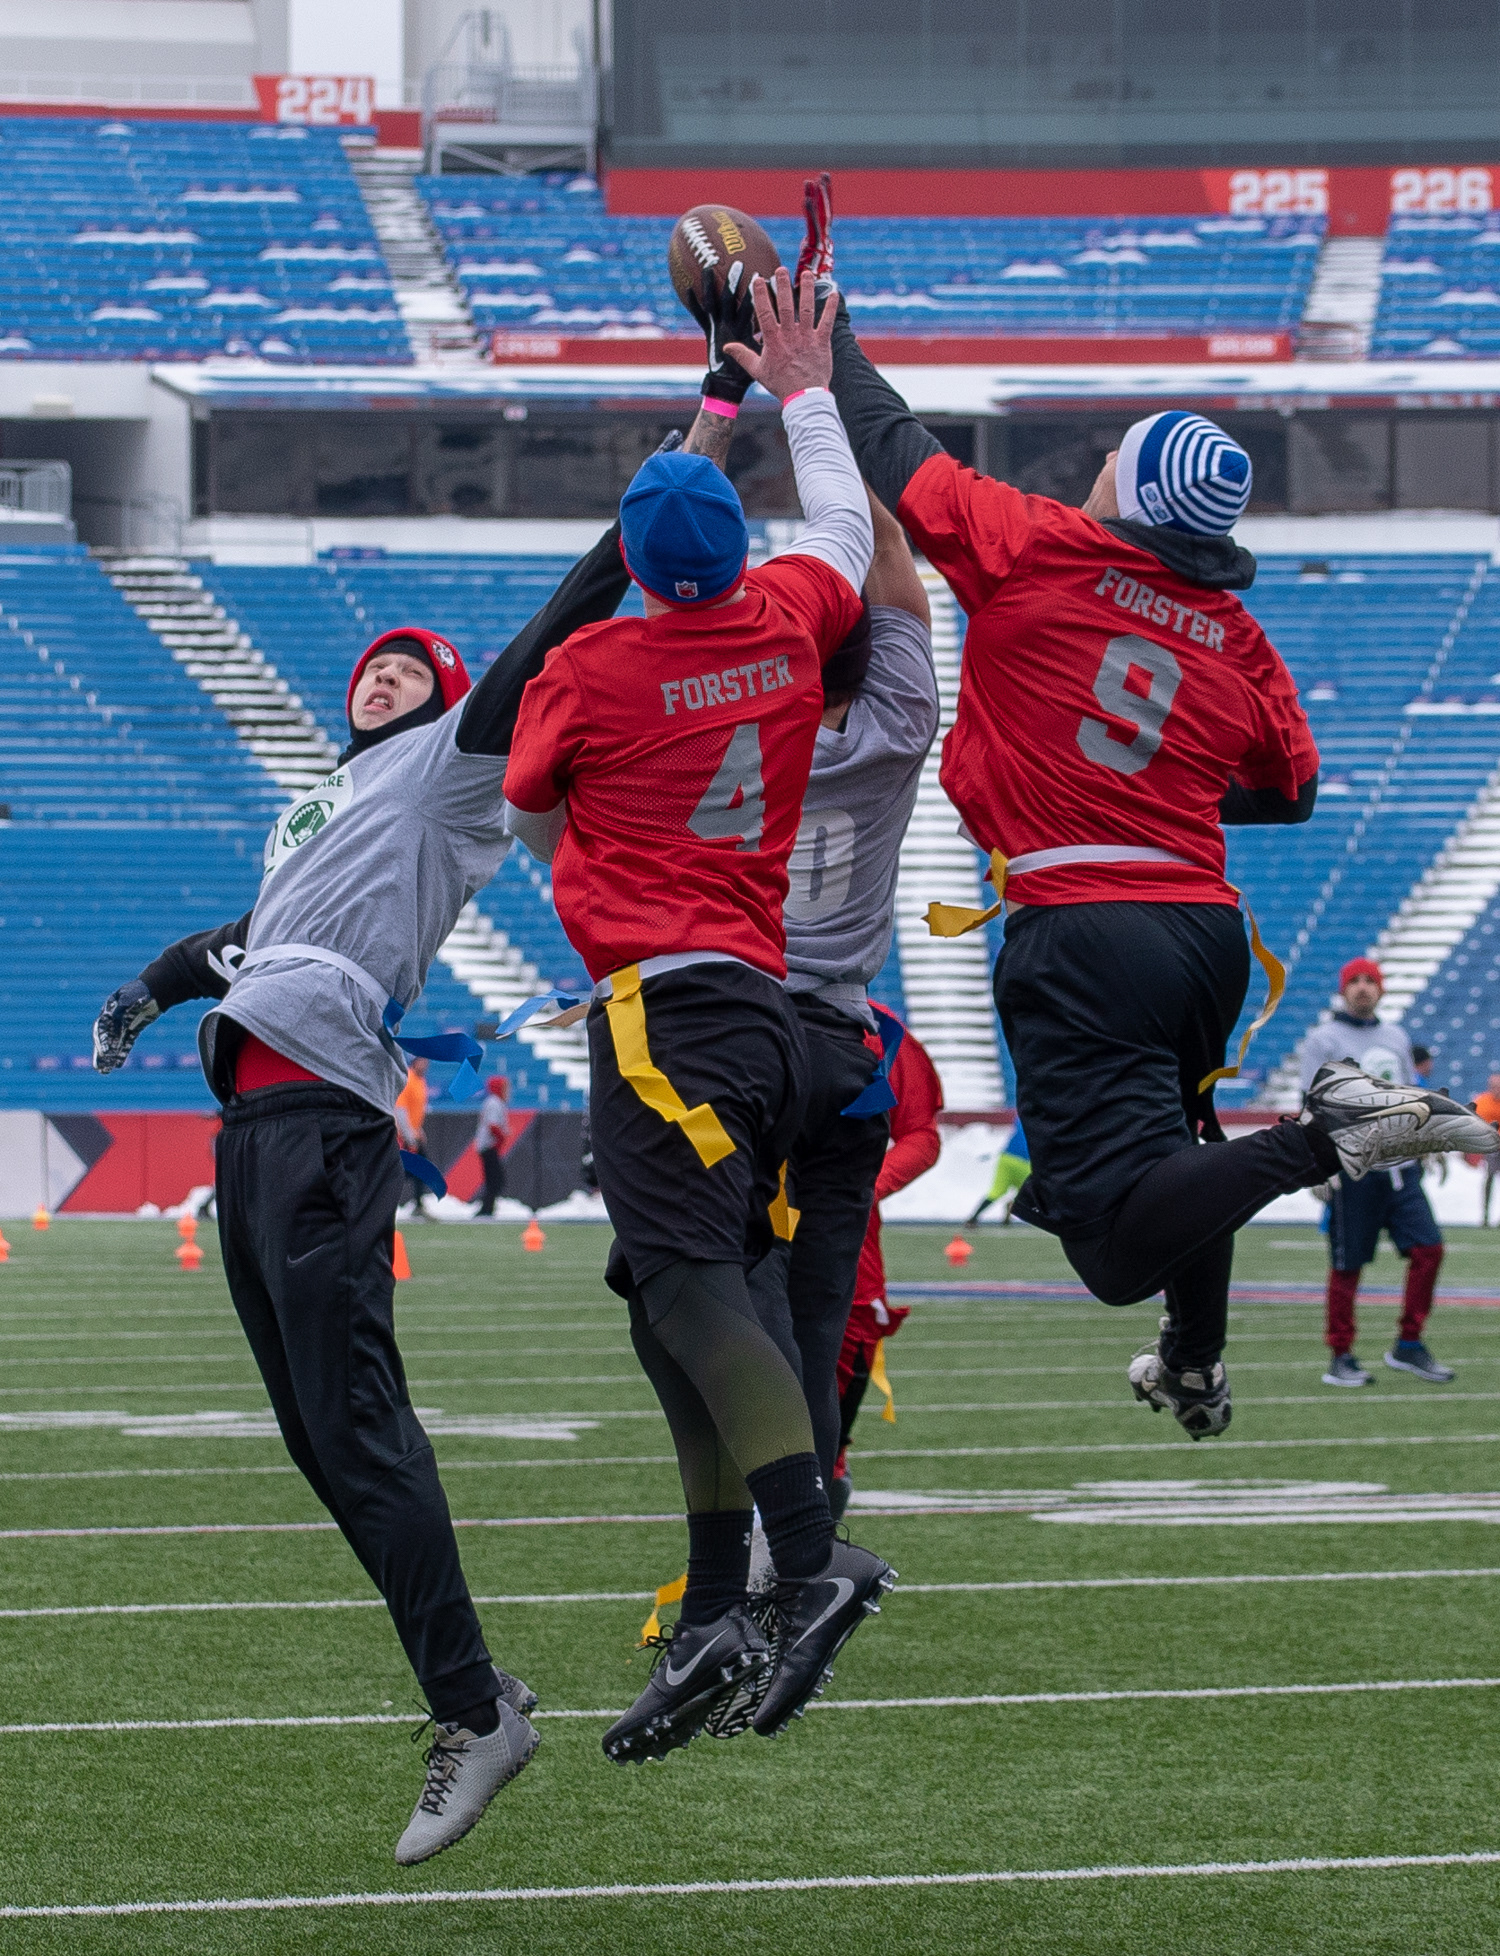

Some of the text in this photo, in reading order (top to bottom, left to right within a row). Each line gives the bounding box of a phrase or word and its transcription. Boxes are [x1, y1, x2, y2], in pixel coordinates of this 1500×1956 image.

[278, 78, 370, 123] 224
[1229, 168, 1330, 215] 225
[1389, 168, 1493, 215] 226
[1094, 566, 1225, 653] FORSTER
[660, 654, 794, 716] FORSTER
[1076, 633, 1184, 776] 9
[686, 722, 766, 852] 4
